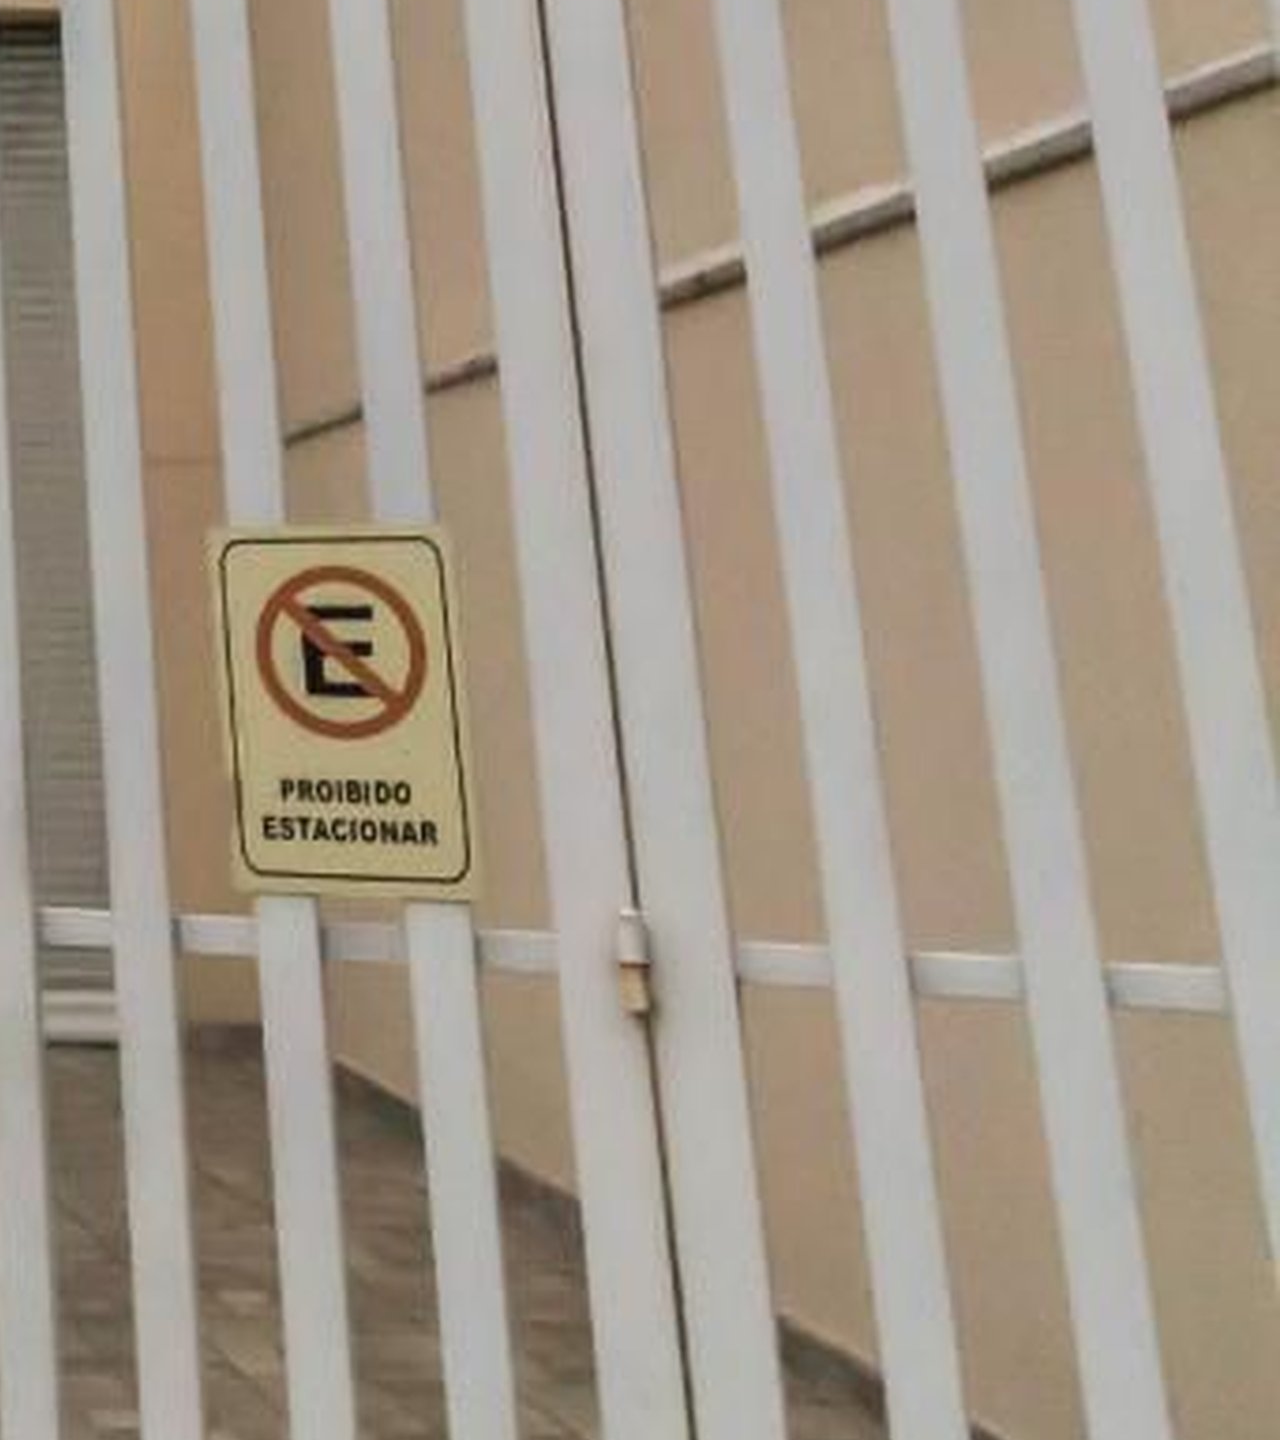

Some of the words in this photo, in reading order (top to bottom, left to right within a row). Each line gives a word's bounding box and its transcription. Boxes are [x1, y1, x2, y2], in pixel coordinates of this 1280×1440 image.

[302, 605, 373, 697] E
[279, 778, 412, 806] PROIBIDO
[261, 815, 439, 846] ESTACIONAR
